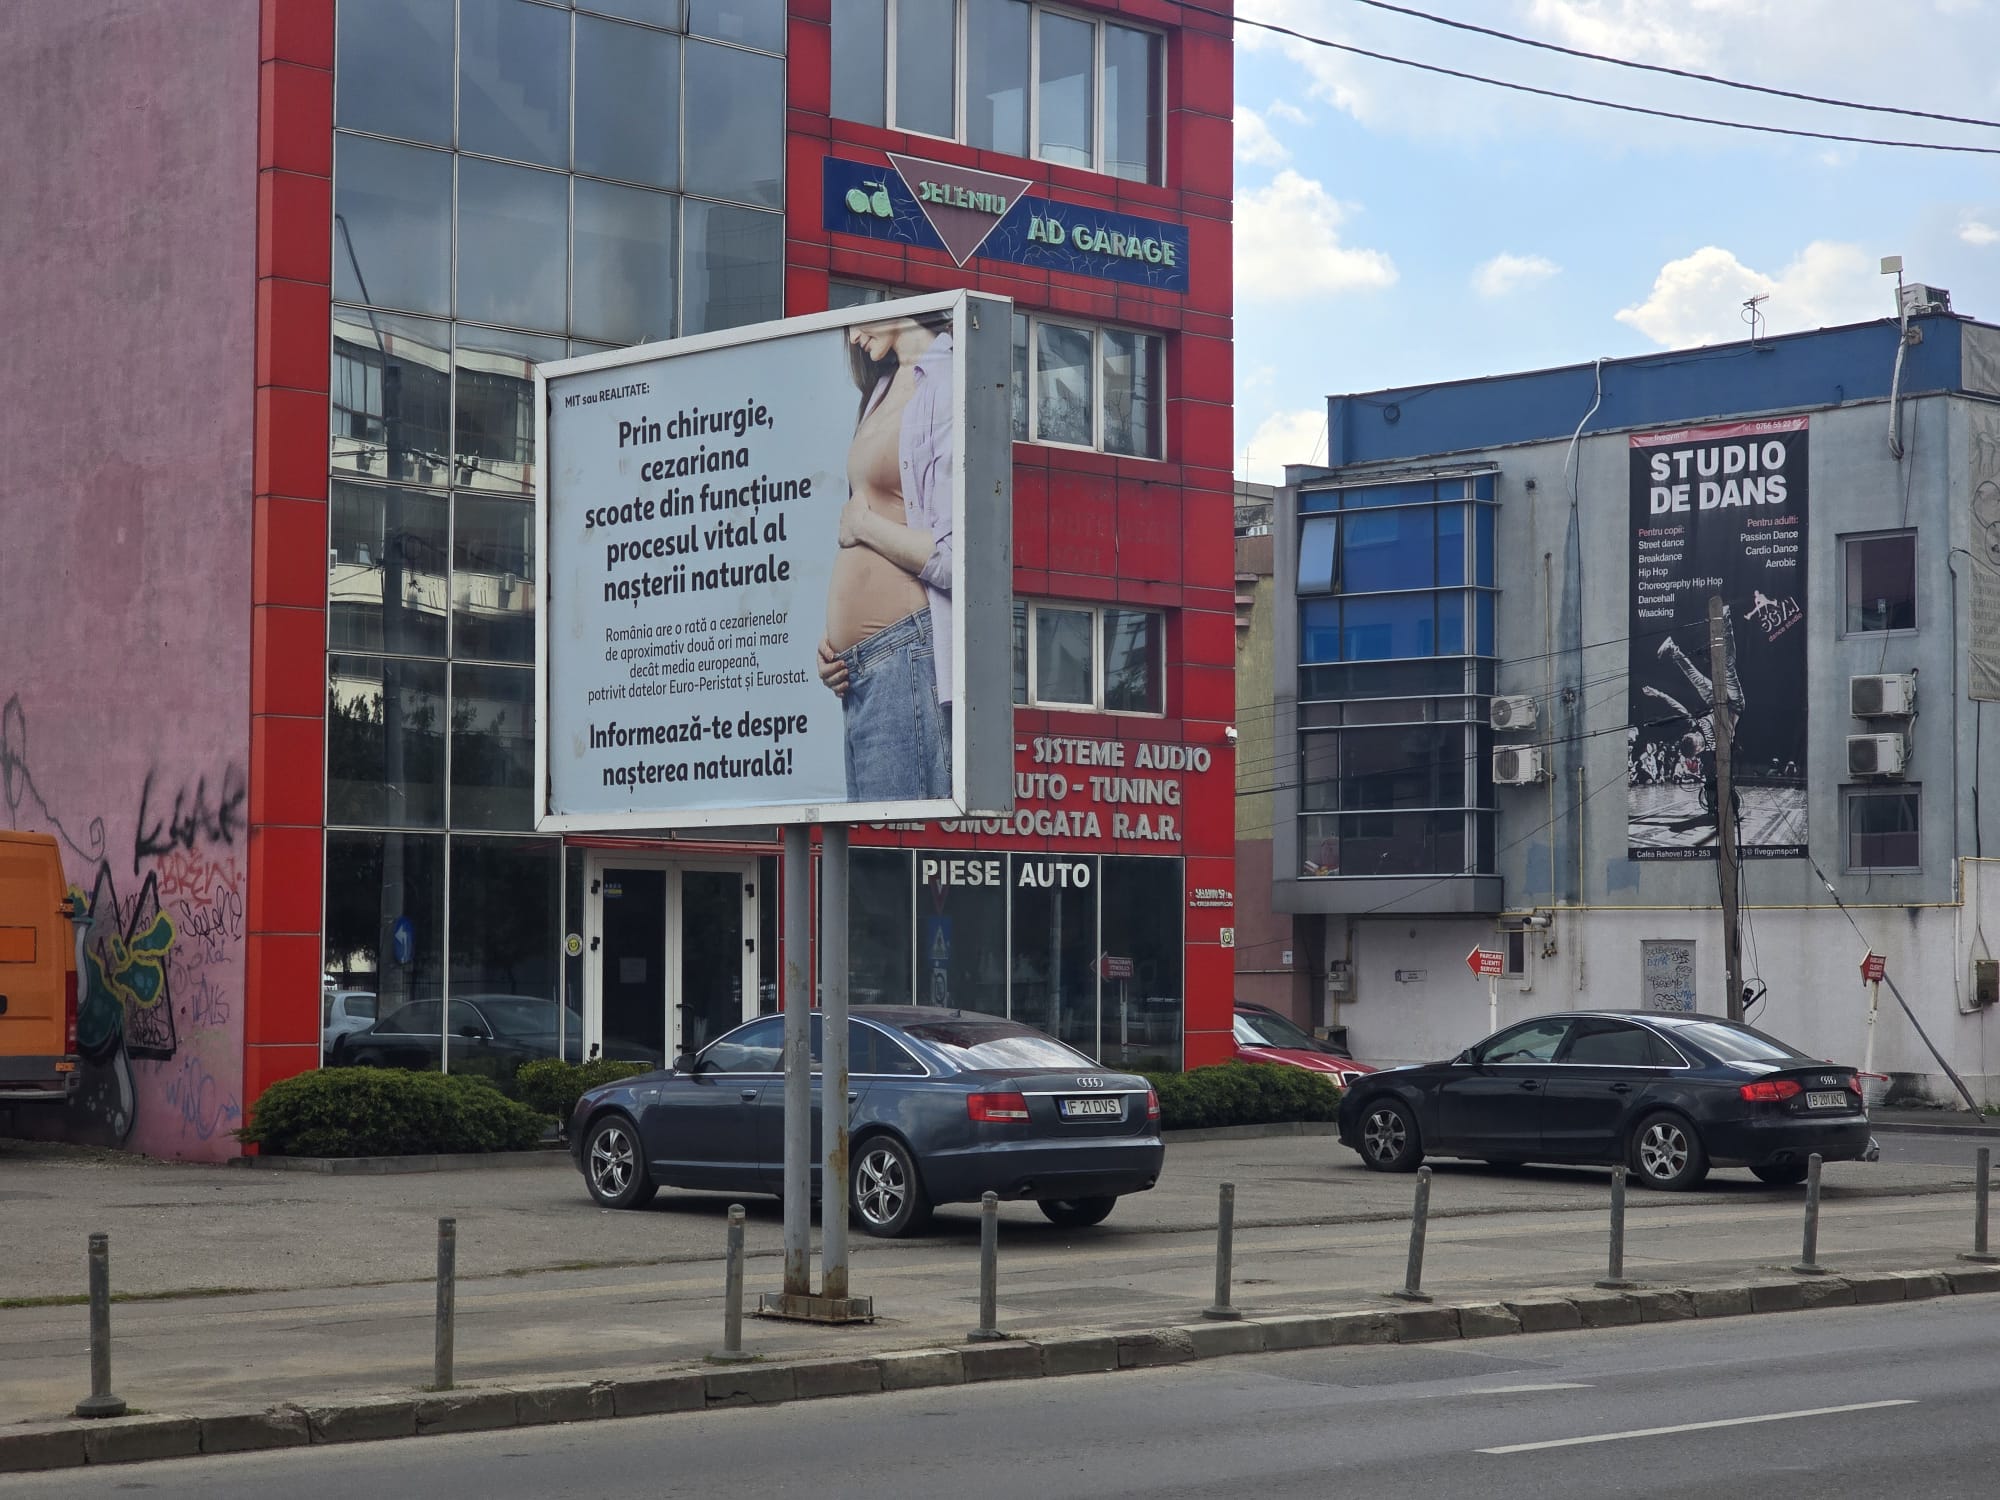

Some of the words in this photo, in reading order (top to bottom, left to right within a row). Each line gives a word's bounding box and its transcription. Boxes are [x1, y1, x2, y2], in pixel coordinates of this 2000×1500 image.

[1027, 216, 1066, 245] AD
[1072, 225, 1176, 266] GARAGE
[565, 395, 581, 408] MIT
[582, 393, 598, 405] sau
[599, 382, 650, 402] REALITATE:
[619, 416, 661, 448] Prin
[667, 398, 774, 440] chirurgie,
[641, 445, 749, 482] cezariana
[1650, 440, 1786, 481] STUDIO
[585, 497, 654, 529] scoate
[660, 488, 694, 518] din
[700, 475, 811, 515] funcțiune
[1650, 484, 1691, 515] DE
[1699, 474, 1788, 510] DANS
[1638, 528, 1663, 537] Pentru
[1664, 526, 1685, 537] copii:
[1740, 532, 1771, 542] Passion
[1773, 530, 1798, 540] Dance
[1747, 518, 1772, 528] Pentru
[607, 524, 698, 571] procesul
[704, 516, 757, 550] vital
[764, 513, 786, 544] al
[1638, 540, 1660, 550] Street
[1661, 538, 1684, 548] dance
[1745, 546, 1771, 556] Cardio
[1773, 544, 1798, 554] Dance
[1638, 552, 1683, 564] Breakdance
[1765, 558, 1796, 569] Aerobic
[604, 565, 685, 608] nașterii
[692, 554, 790, 591] naturale
[1638, 568, 1651, 579] Hip
[1652, 567, 1668, 578] Hop
[1638, 579, 1691, 591] Choreography
[1692, 578, 1705, 588] Hip
[1707, 577, 1723, 587] Hop
[1638, 593, 1675, 604] Dancehall
[606, 625, 652, 642] România
[656, 624, 671, 637] are
[675, 624, 682, 635] o
[685, 618, 707, 634] rată
[710, 621, 717, 632] a
[719, 610, 789, 630] cezarienelor
[1638, 608, 1674, 619] Waacking
[605, 645, 618, 662] de
[620, 640, 684, 664] aproximativ
[687, 637, 715, 654] două
[718, 635, 733, 650] ori
[736, 632, 757, 648] mai
[760, 631, 789, 646] mare
[629, 660, 659, 679] decât
[662, 656, 695, 676] media
[698, 652, 760, 674] europeană,
[588, 684, 626, 705] potrivit
[628, 681, 667, 699] datelor
[670, 675, 742, 695] Euro-Peristat
[745, 673, 754, 692] și
[757, 669, 809, 687] Eurostat.
[590, 715, 732, 749] Informează-te
[737, 711, 808, 743] despre
[1033, 736, 1125, 768] SISTEME
[1134, 743, 1211, 773] AUDIO
[603, 760, 688, 794] nașterea
[694, 748, 793, 780] naturală!
[1014, 773, 1067, 801] UTO
[1089, 775, 1181, 807] TUNING
[1112, 813, 1182, 842] R.A.R.
[922, 859, 1000, 886] PIESE
[1018, 861, 1090, 888] AUTO
[1067, 1101, 1077, 1114] IF
[1080, 1100, 1092, 1114] 21
[1094, 1100, 1117, 1114] DVS
